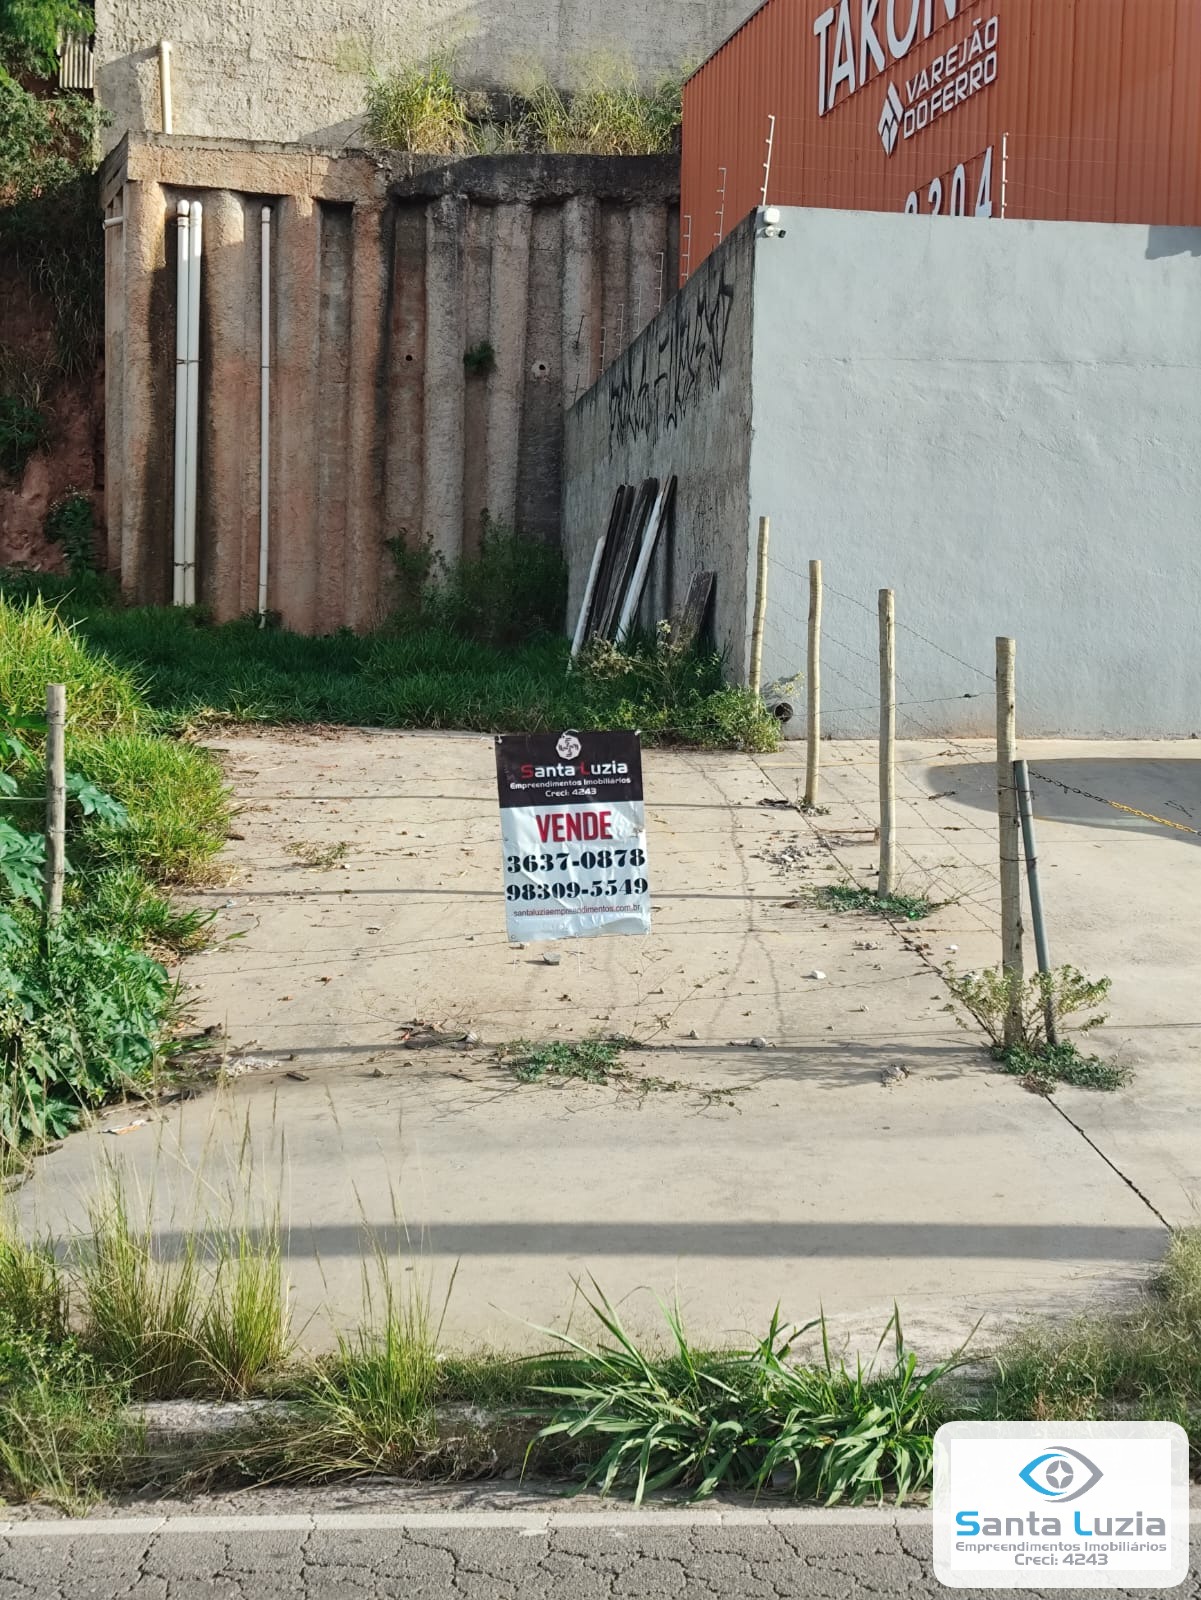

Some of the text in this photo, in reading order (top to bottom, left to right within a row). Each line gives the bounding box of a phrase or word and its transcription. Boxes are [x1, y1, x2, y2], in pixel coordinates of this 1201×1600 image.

[905, 16, 998, 103] VAREJÃO
[520, 760, 628, 779] Santa Luzia
[510, 779, 582, 790] Empreendimentos
[571, 787, 597, 795] 4243
[535, 811, 613, 843] VENDE
[507, 848, 646, 873] 3637-0878
[506, 878, 648, 901] 98309-5549
